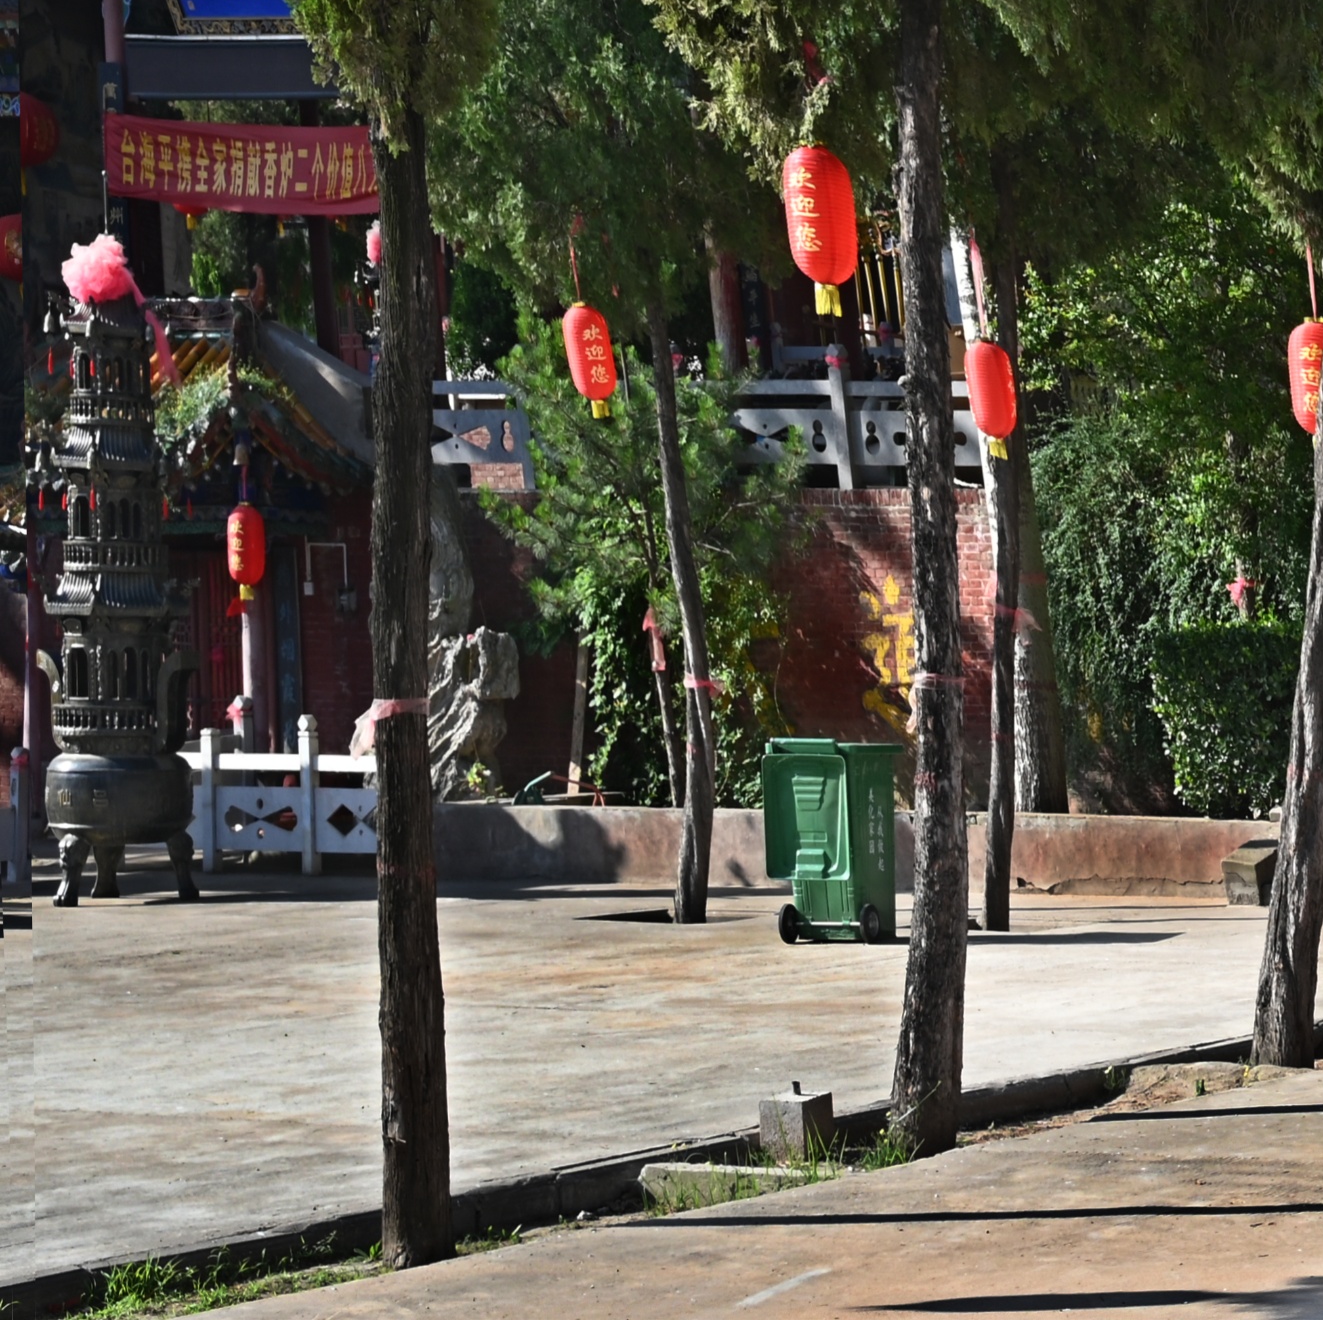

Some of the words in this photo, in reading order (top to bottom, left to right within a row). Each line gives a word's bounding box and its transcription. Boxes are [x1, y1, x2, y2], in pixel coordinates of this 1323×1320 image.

[788, 165, 822, 252] 欢迎您
[582, 324, 610, 384] 欢迎您
